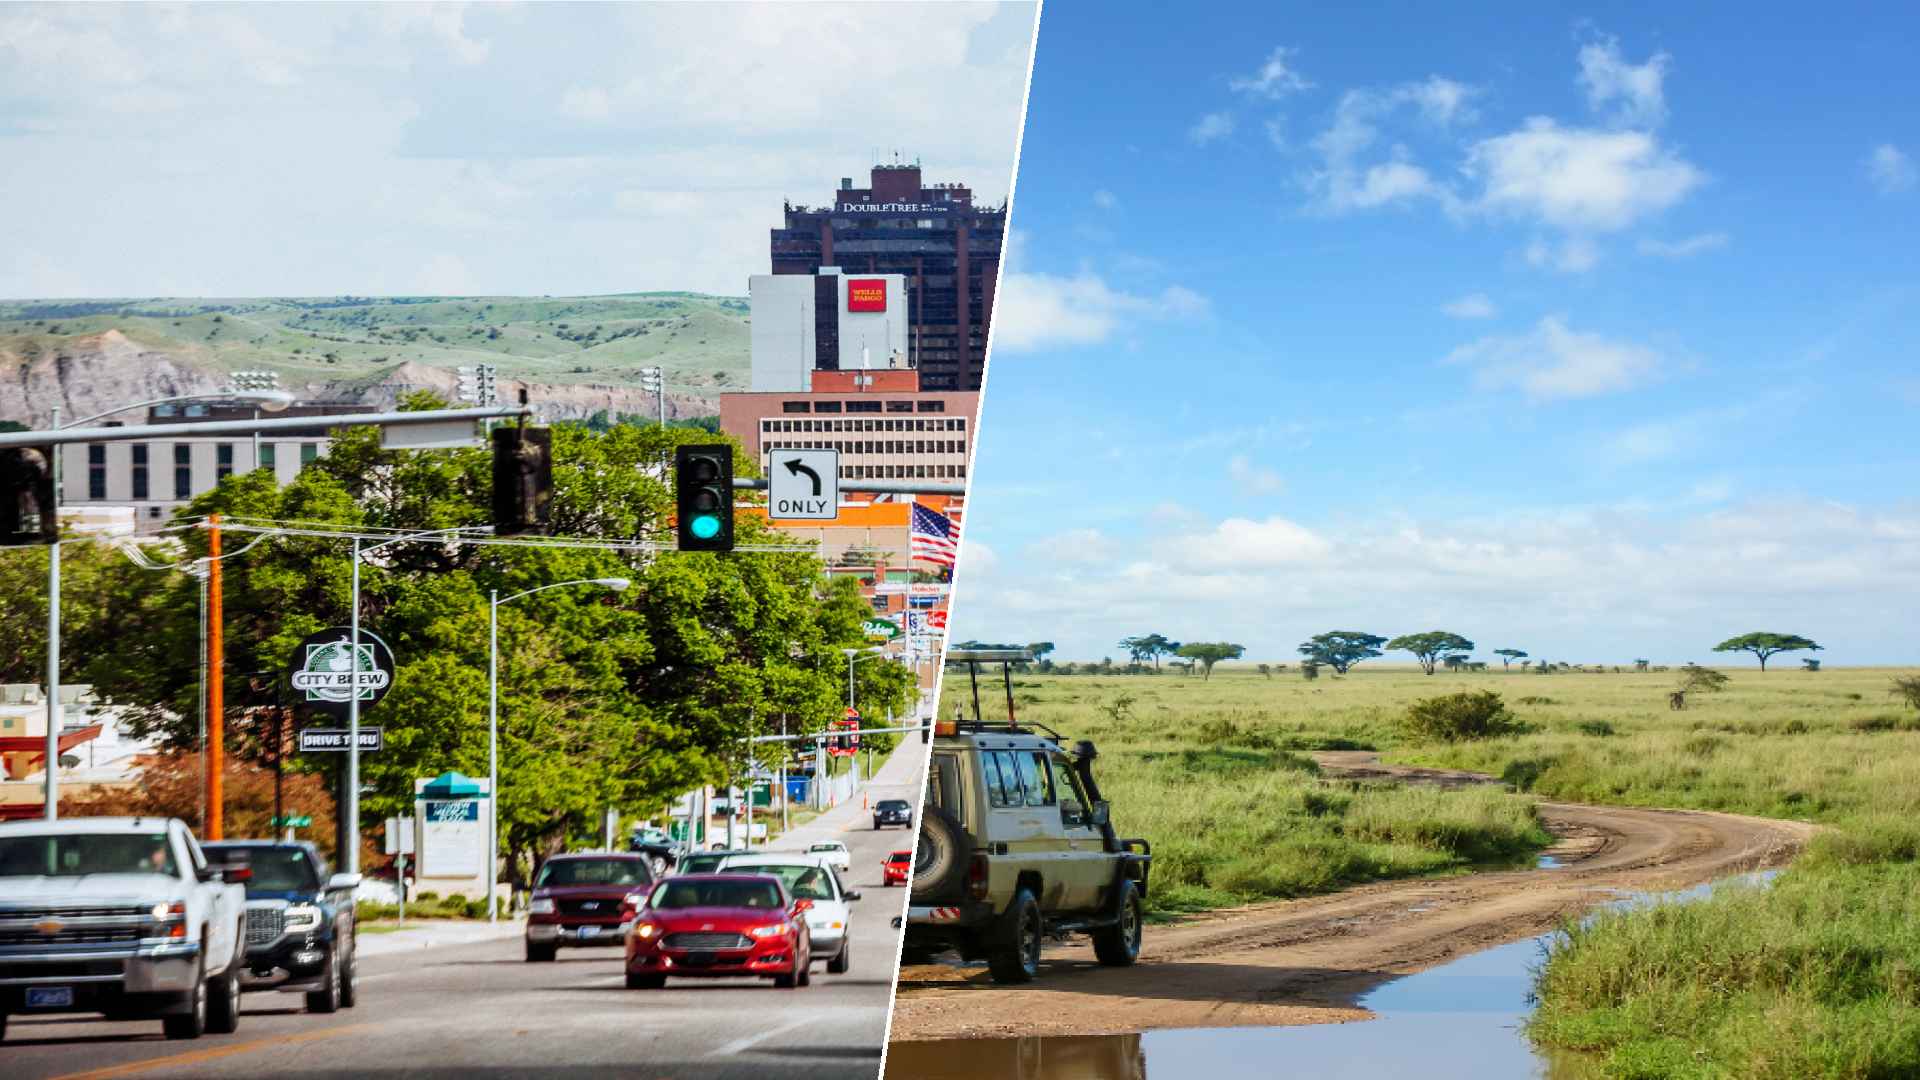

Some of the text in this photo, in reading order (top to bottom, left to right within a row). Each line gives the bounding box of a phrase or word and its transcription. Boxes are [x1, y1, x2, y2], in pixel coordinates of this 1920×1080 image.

[778, 499, 827, 513] ONLY
[297, 674, 332, 685] CITY
[304, 735, 377, 746] DRIVE TRU
